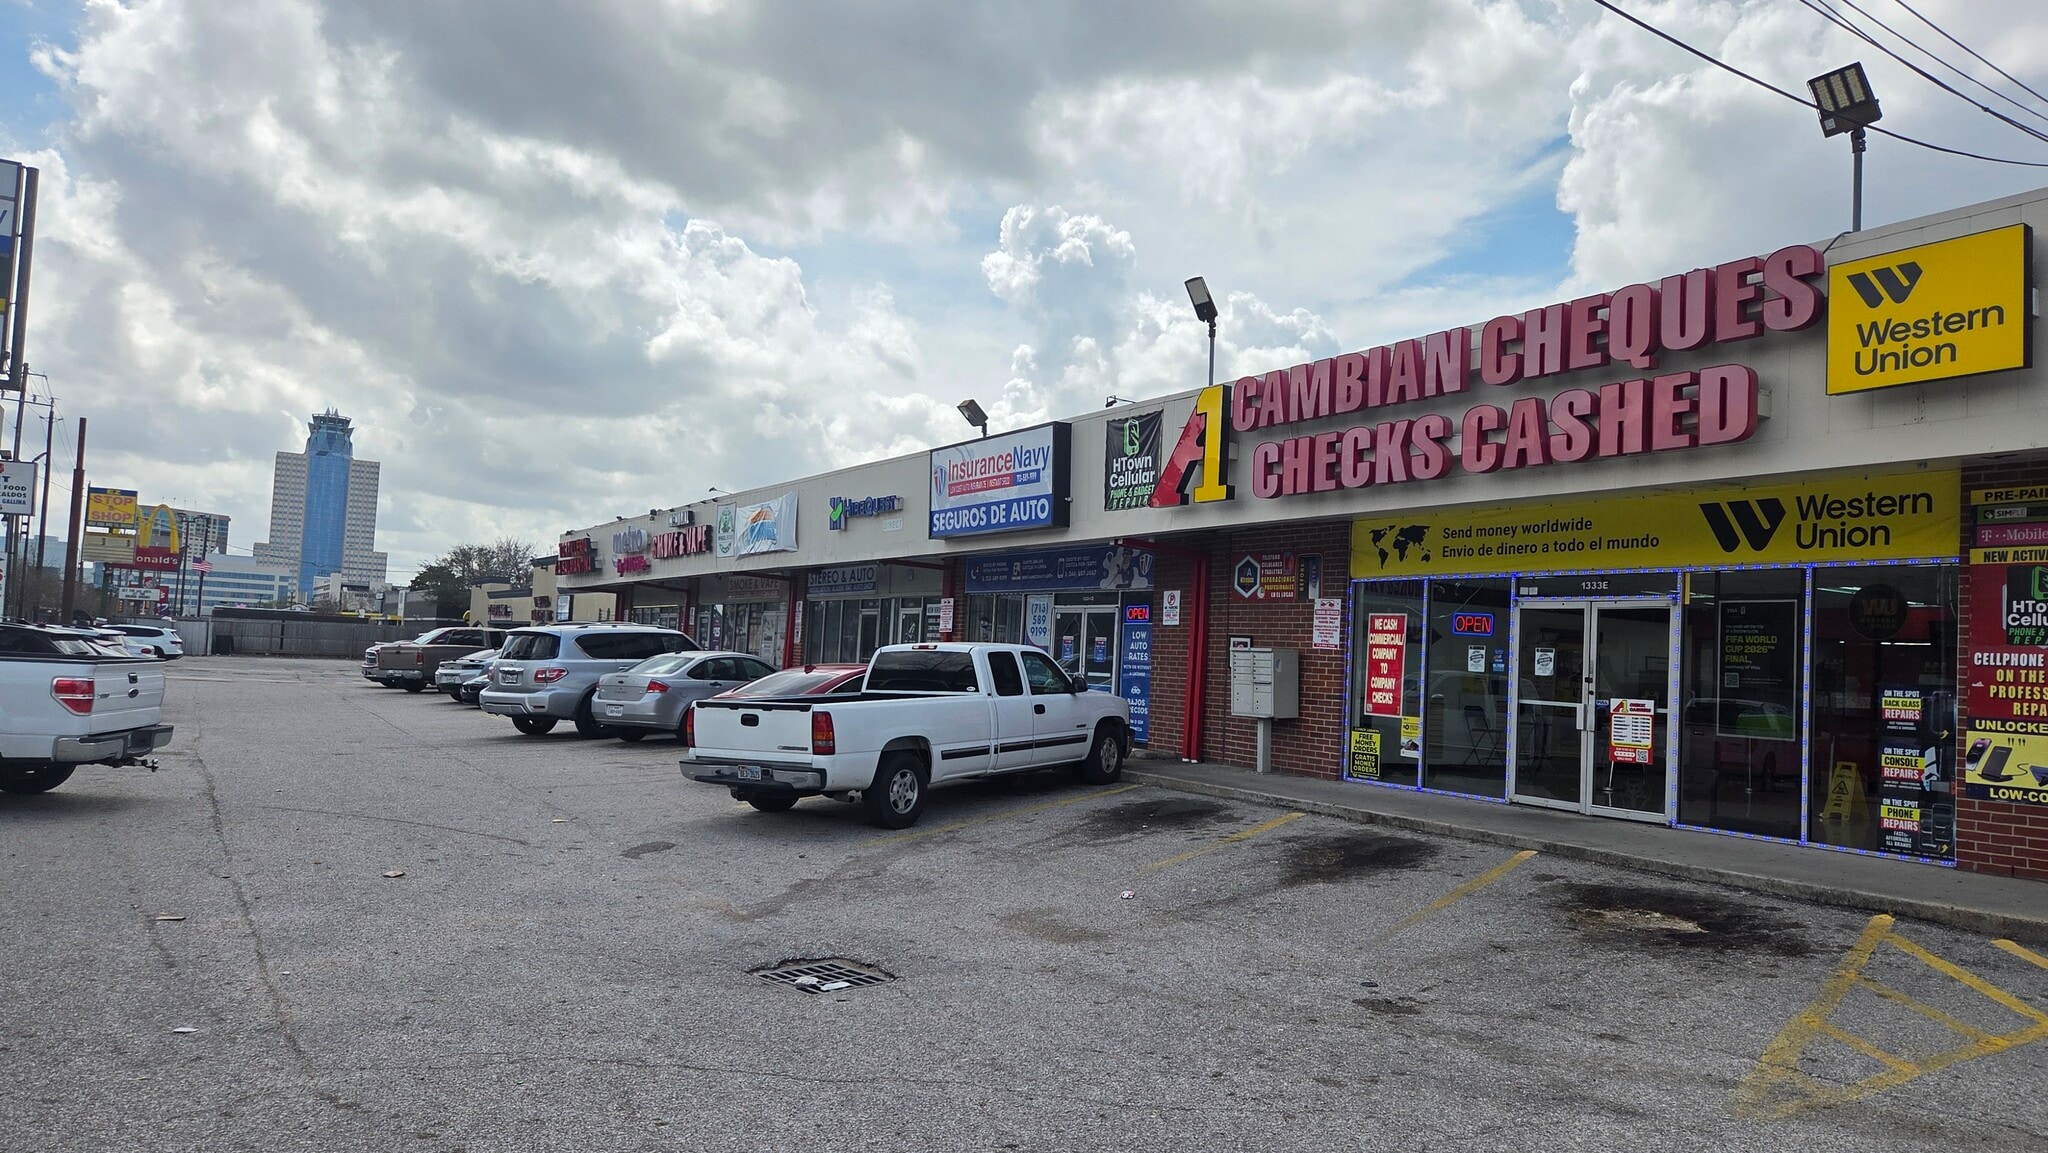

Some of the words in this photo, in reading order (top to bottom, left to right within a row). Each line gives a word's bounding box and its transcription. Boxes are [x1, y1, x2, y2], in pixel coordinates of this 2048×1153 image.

[1856, 304, 2005, 349] Western
[1232, 327, 1471, 432] CAMBIAN
[1481, 245, 1824, 386] CHEQUES
[1854, 342, 1957, 376] Union
[1253, 414, 1453, 498] CHECKS
[1462, 364, 1758, 473] CASHED
[1148, 385, 1235, 507] A1
[948, 445, 1050, 481] InsuranceNavy
[1113, 455, 1152, 473] HTown
[1109, 470, 1155, 487] Cellular
[1110, 488, 1128, 499] PHONE
[1984, 488, 2048, 502] PRE-PAI
[94, 495, 133, 506] STOP
[1795, 491, 1933, 522] Western
[91, 511, 132, 521] SHOP
[933, 506, 987, 532] SEGUROS
[991, 504, 1006, 524] DE
[1010, 498, 1049, 522] AUTO
[1996, 507, 2026, 518] SIMPLE
[1442, 525, 1473, 539] Send
[1475, 525, 1518, 539] money
[1521, 517, 1593, 533] worldwide
[1795, 520, 1891, 550] Union
[652, 532, 679, 559] SMOKE
[679, 533, 686, 556] &
[686, 525, 707, 553] VAPE
[1442, 544, 1475, 558] Envio
[1477, 543, 1493, 556] de
[1497, 542, 1538, 555] dinero
[1541, 542, 1549, 552] a
[1553, 538, 1585, 552] todo
[1589, 537, 1602, 550] el
[1606, 533, 1660, 550] mundo
[136, 555, 178, 565] onald's
[1983, 551, 2009, 563] NEW
[810, 570, 839, 585] STEREO
[841, 570, 848, 583] &
[849, 567, 875, 582] AUTO
[730, 578, 752, 590] SMOKE
[1581, 581, 1609, 590] 1333E
[1031, 603, 1049, 615] (713)
[2012, 600, 2048, 613] HTo
[1032, 615, 1047, 625] 589
[1128, 608, 1149, 620] OPEN
[1374, 618, 1382, 630] WE
[1382, 618, 1398, 630] CASH
[1455, 615, 1491, 633] OPEN
[1030, 627, 1048, 637] 9199
[1132, 631, 1147, 640] LOW
[2009, 628, 2037, 636] PHONE
[2038, 627, 2045, 636] &
[1725, 635, 1744, 643] FIFA
[1745, 635, 1778, 643] WORLD
[1130, 642, 1148, 650] AUTO
[1725, 645, 1743, 653] CUP
[1128, 653, 1149, 661] RATES
[1372, 647, 1397, 661] COMPANY
[1725, 655, 1752, 664] FINAL,
[1973, 652, 2045, 667] CELLPHONE
[1380, 662, 1388, 674] TO
[1996, 668, 2015, 682] ON
[2019, 669, 2046, 684] THE
[1370, 677, 1396, 690] COMPANY
[1371, 691, 1394, 704] CHECKS
[1904, 690, 1920, 698] SPOT
[1989, 684, 2048, 700] PROFESS
[1884, 699, 1900, 707] BACK
[1901, 699, 1920, 708] GLASS
[1130, 707, 1148, 715] ECIOS
[1884, 708, 1920, 720] REPAIRS
[1975, 719, 2048, 734] UNLOCKE
[1358, 733, 1373, 741] FREE
[1353, 745, 1378, 753] ORDERS
[1354, 739, 1377, 748] MONEY
[1884, 747, 1892, 755] ON
[1893, 748, 1903, 756] THE
[1904, 748, 1920, 756] SPOT
[1354, 754, 1376, 762] GRATIS
[1354, 760, 1375, 768] MONEY
[1884, 756, 1919, 767] CONSOLE
[1353, 766, 1377, 774] ORDERS
[1884, 767, 1919, 779] REPAIRS
[1989, 787, 2048, 803] LOW-CO
[1892, 799, 1902, 807] THE
[1903, 799, 1919, 808] SPOT
[1887, 806, 1914, 819] PHONE
[1883, 818, 1919, 831] REPAIRS
